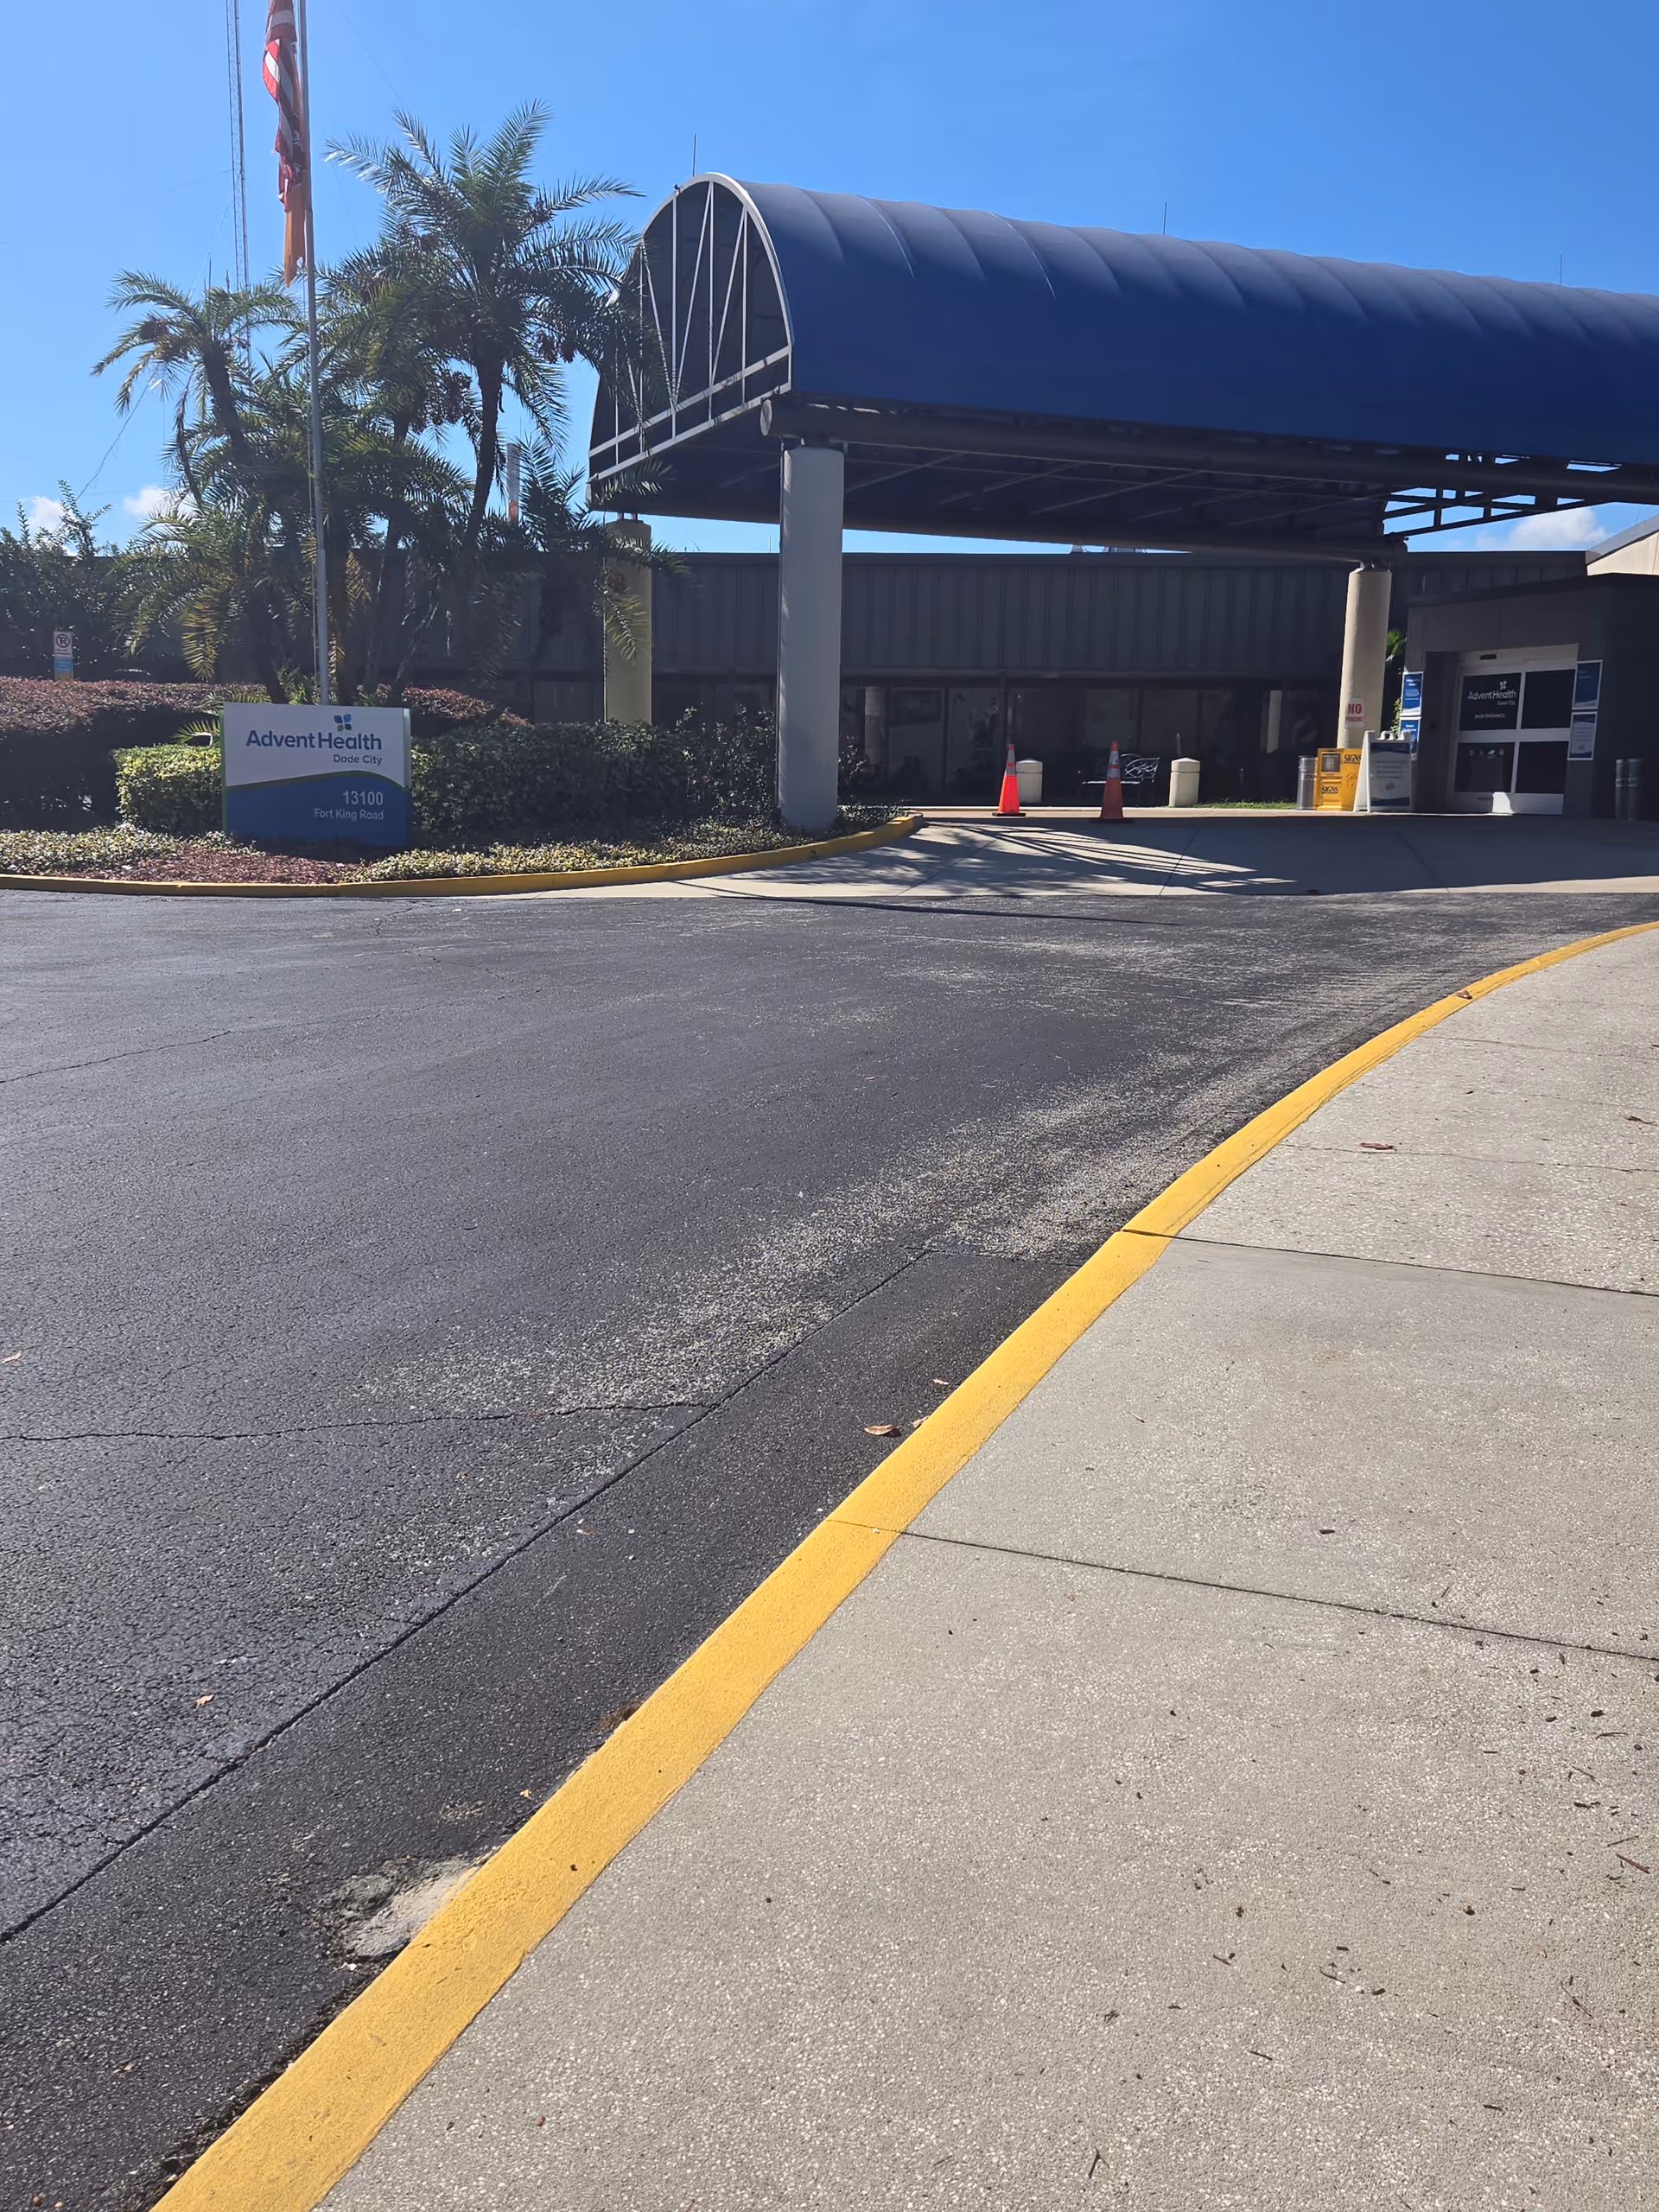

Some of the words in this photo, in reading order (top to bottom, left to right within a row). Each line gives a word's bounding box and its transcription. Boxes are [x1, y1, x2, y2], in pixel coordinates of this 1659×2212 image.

[1467, 690, 1516, 700] AdventHealth
[1347, 703, 1362, 715] NO
[245, 729, 382, 750] AdventHealth
[334, 754, 359, 764] Dade
[362, 754, 383, 766] City
[343, 791, 383, 805] 13100
[314, 808, 334, 818] Fort
[335, 809, 357, 821] King
[359, 810, 384, 820] Road
